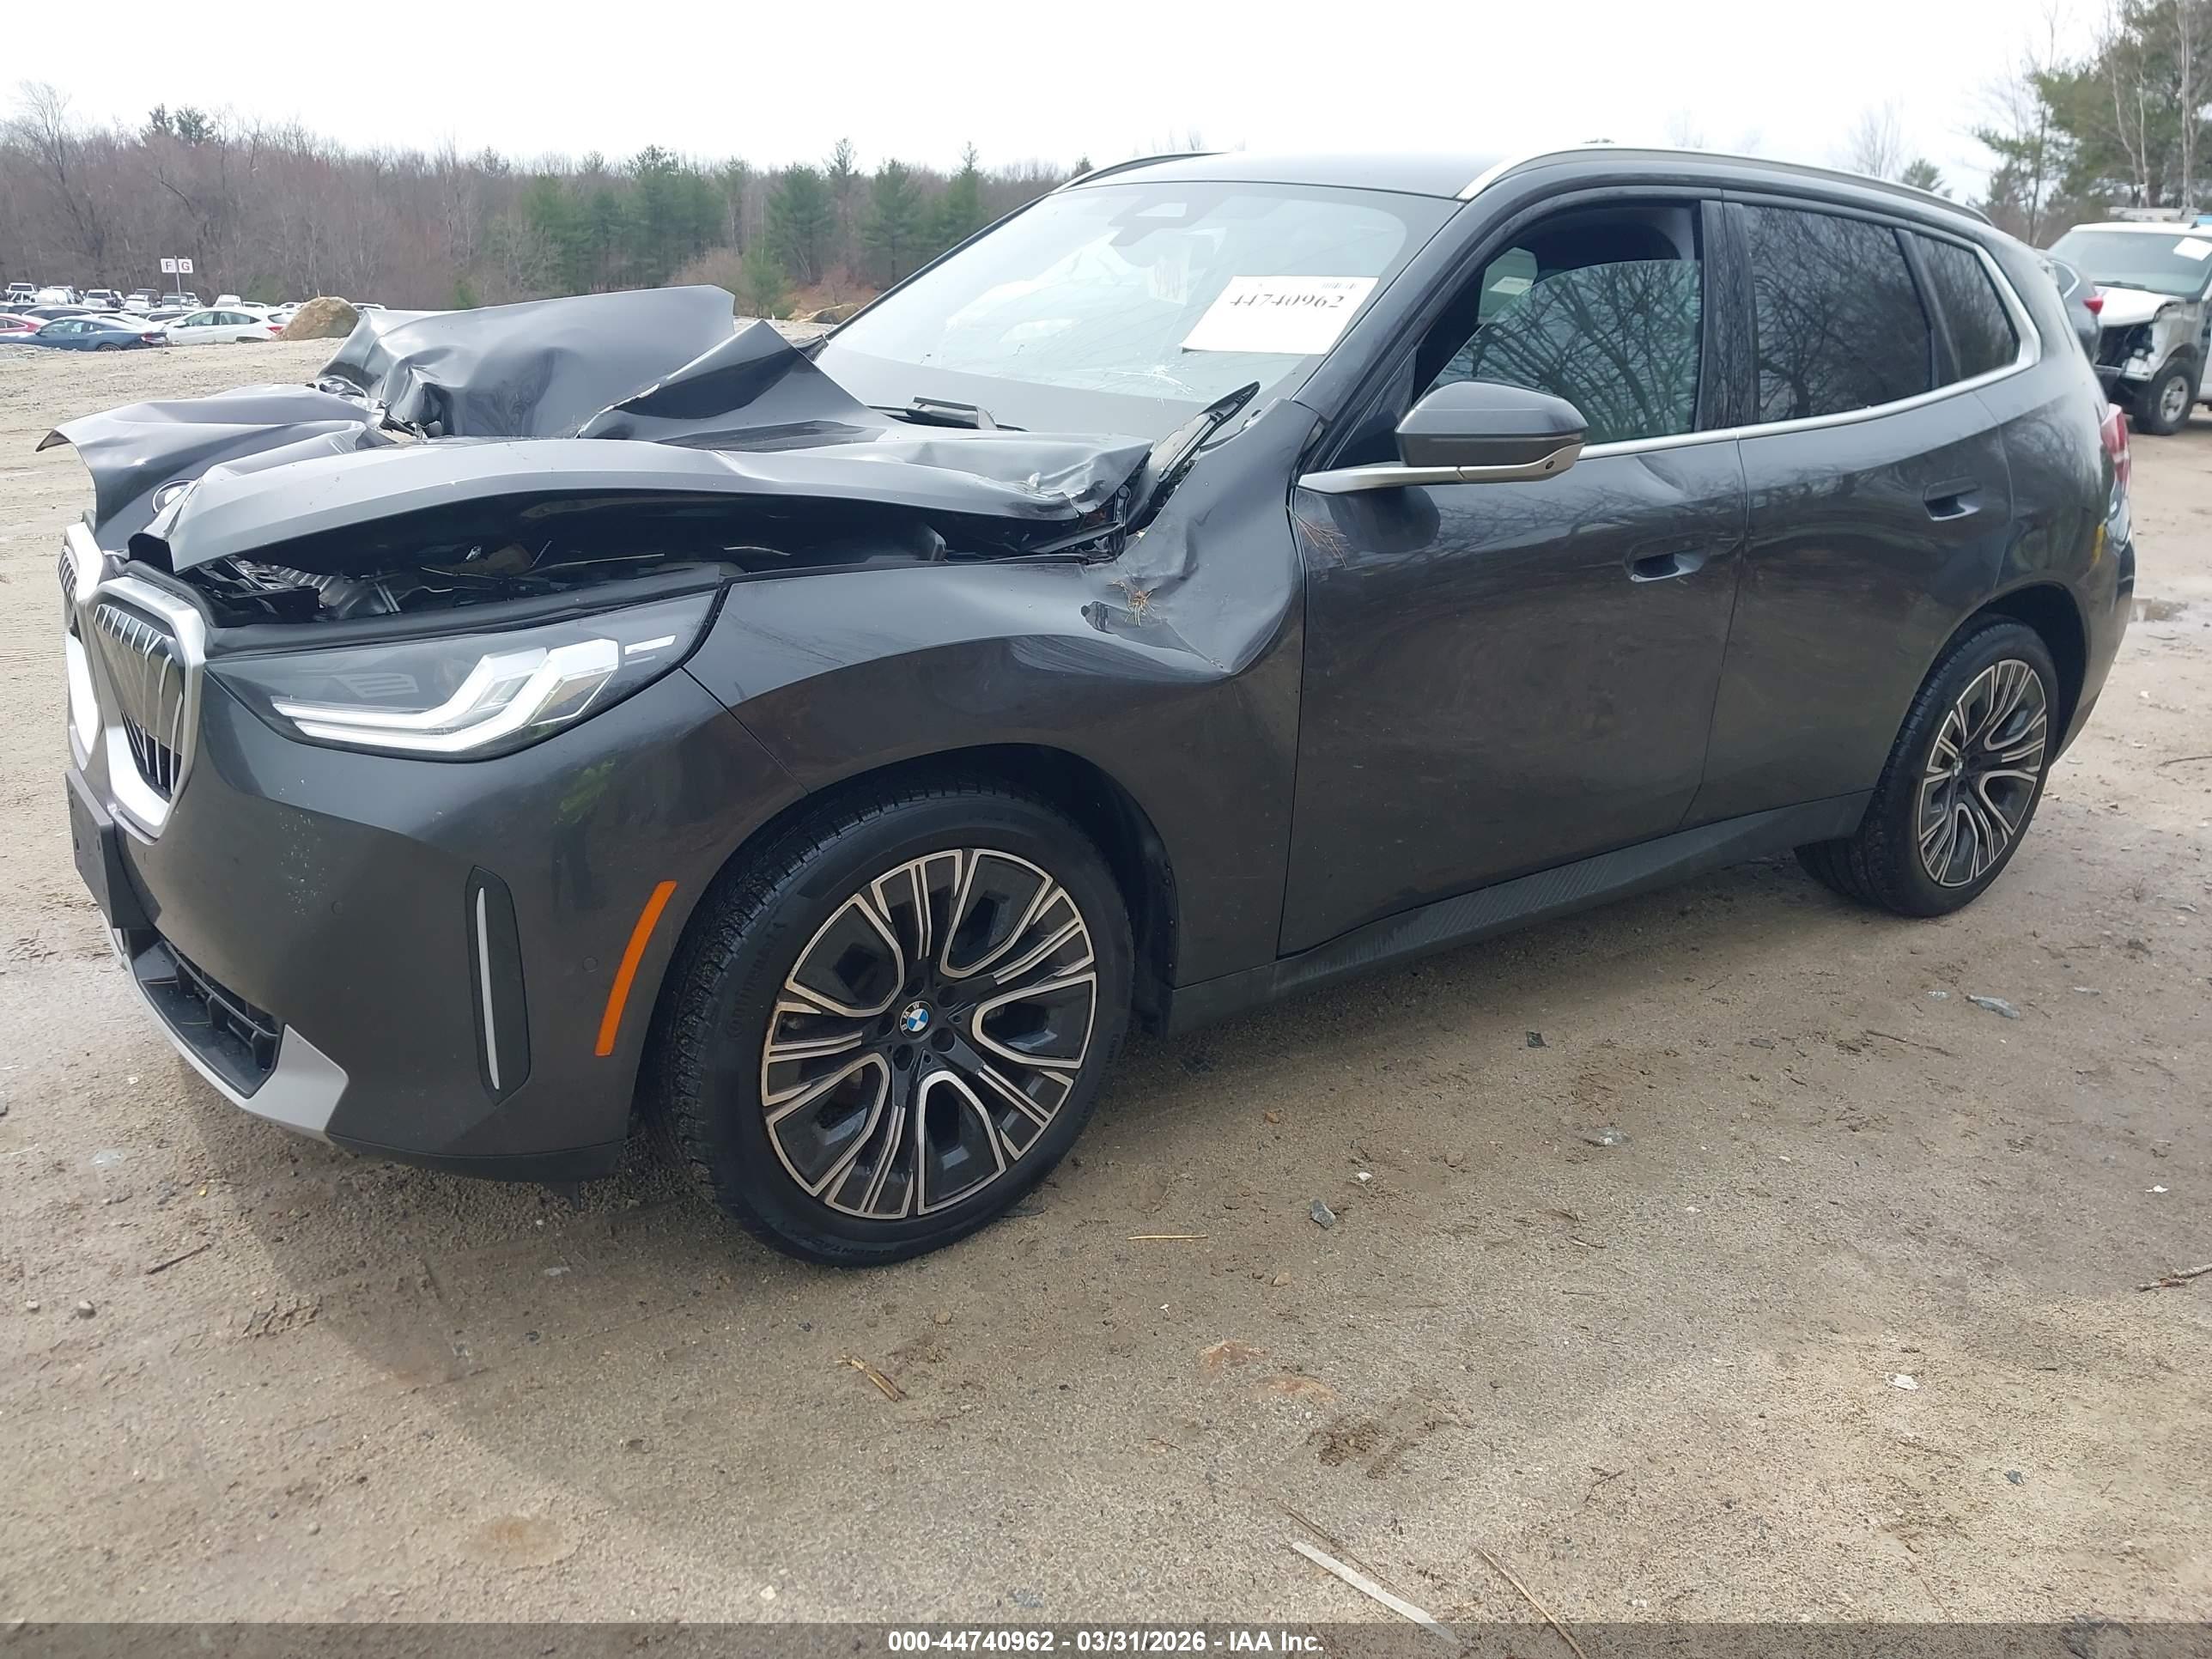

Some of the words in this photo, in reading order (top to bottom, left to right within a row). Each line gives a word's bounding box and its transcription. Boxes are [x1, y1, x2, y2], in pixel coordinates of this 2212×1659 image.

[165, 261, 172, 270] F
[181, 261, 190, 270] G
[1230, 293, 1346, 308] 44740962
